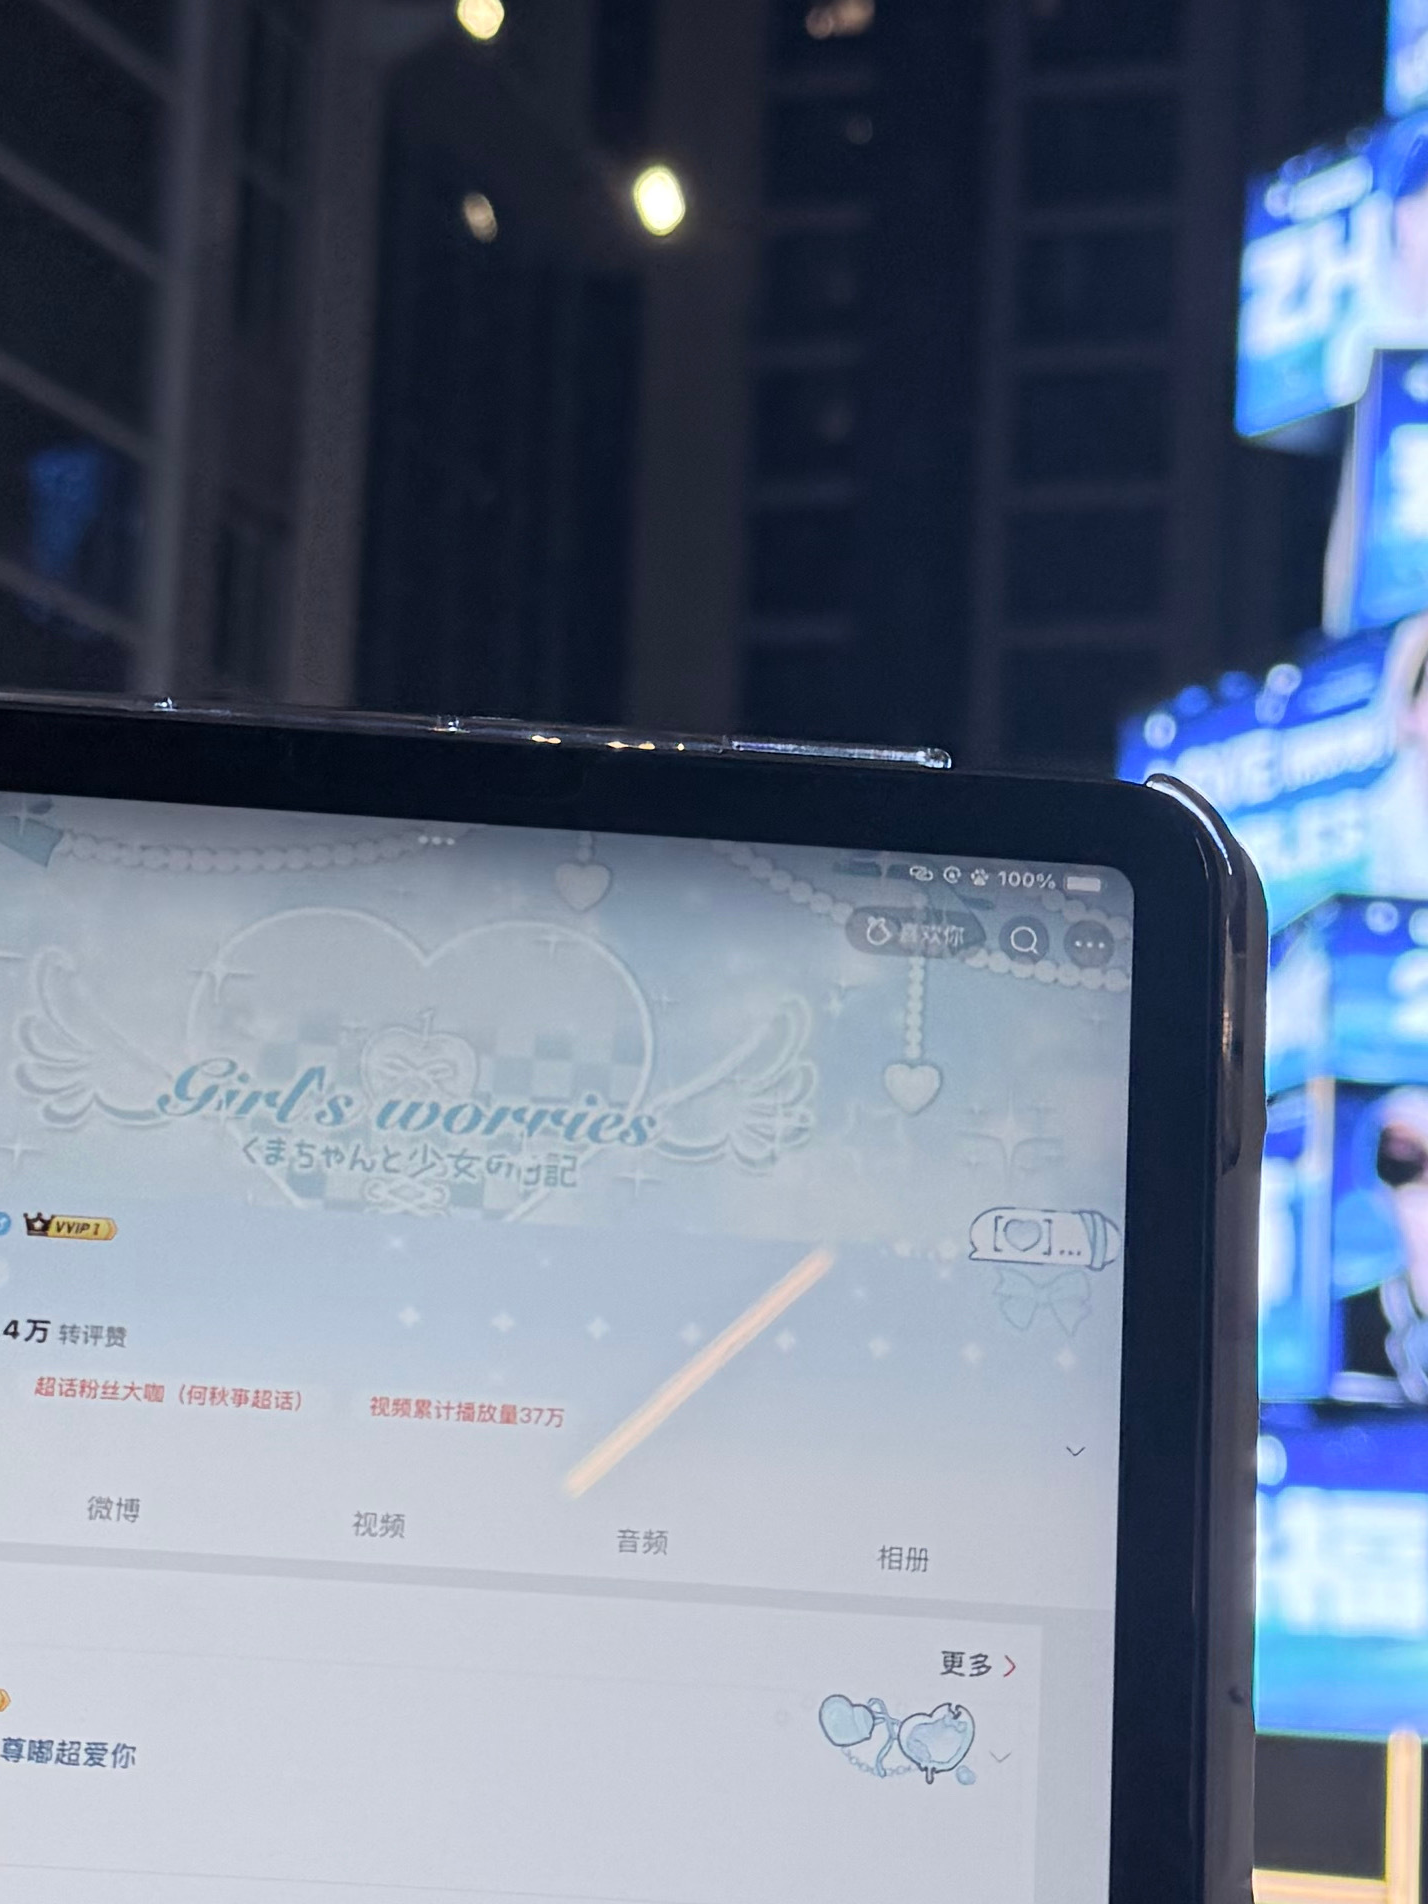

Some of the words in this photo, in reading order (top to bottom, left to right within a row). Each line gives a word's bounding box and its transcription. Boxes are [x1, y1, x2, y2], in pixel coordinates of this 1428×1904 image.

[997, 869, 1057, 890] 100%
[157, 1057, 354, 1128] Girl's
[376, 1094, 658, 1148] worries
[58, 1323, 128, 1349] 转评赞
[369, 1396, 566, 1429] 视频累计播放量37万
[87, 1495, 141, 1524] 微博
[353, 1510, 407, 1539] 视频
[617, 1528, 669, 1556] 音频
[877, 1545, 930, 1573] 相册
[939, 1650, 993, 1678] 更多
